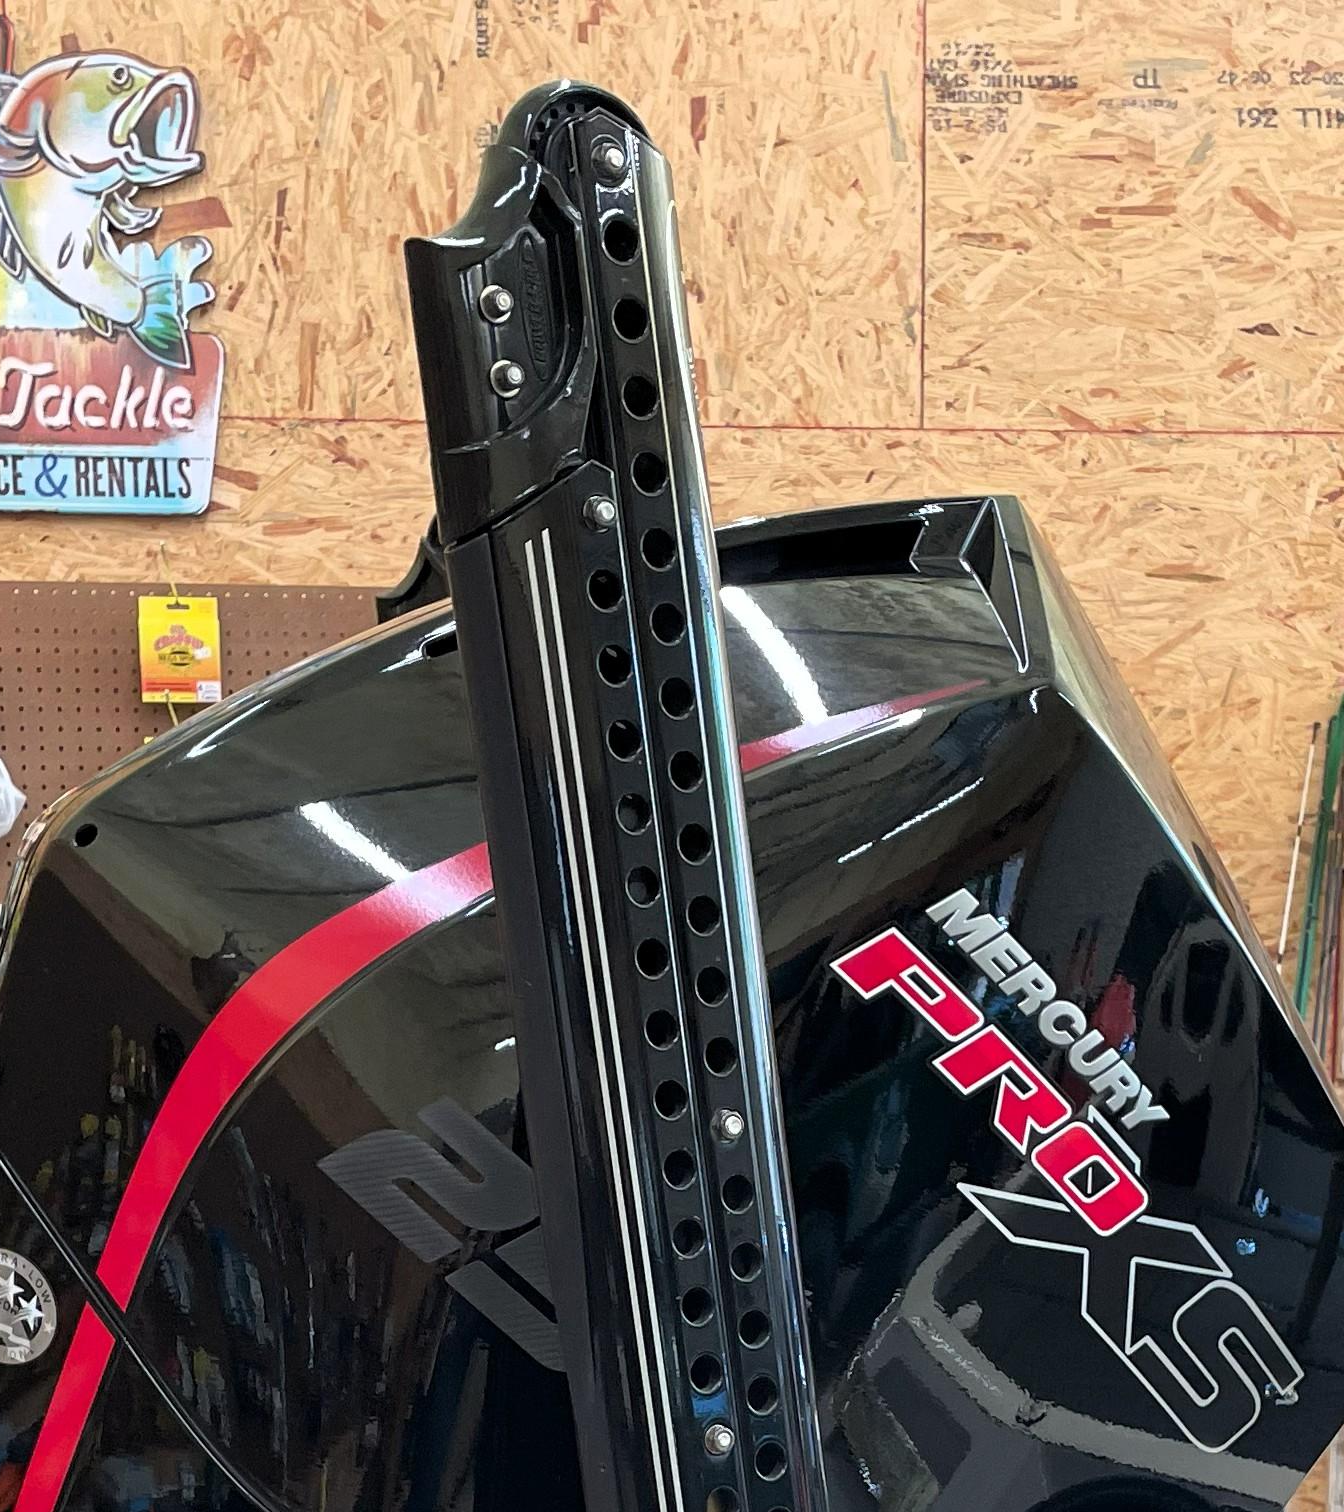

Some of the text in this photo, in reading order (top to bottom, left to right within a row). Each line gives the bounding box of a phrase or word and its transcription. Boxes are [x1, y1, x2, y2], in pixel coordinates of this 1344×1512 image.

[1133, 68, 1161, 89] TP
[1232, 108, 1279, 129] 361
[34, 453, 68, 499] &
[75, 455, 192, 499] RENTALS
[926, 888, 1171, 1130] MERCURY
[830, 926, 1150, 1238] PRO
[27, 1269, 53, 1305] LOW
[957, 1105, 1305, 1455] XS
